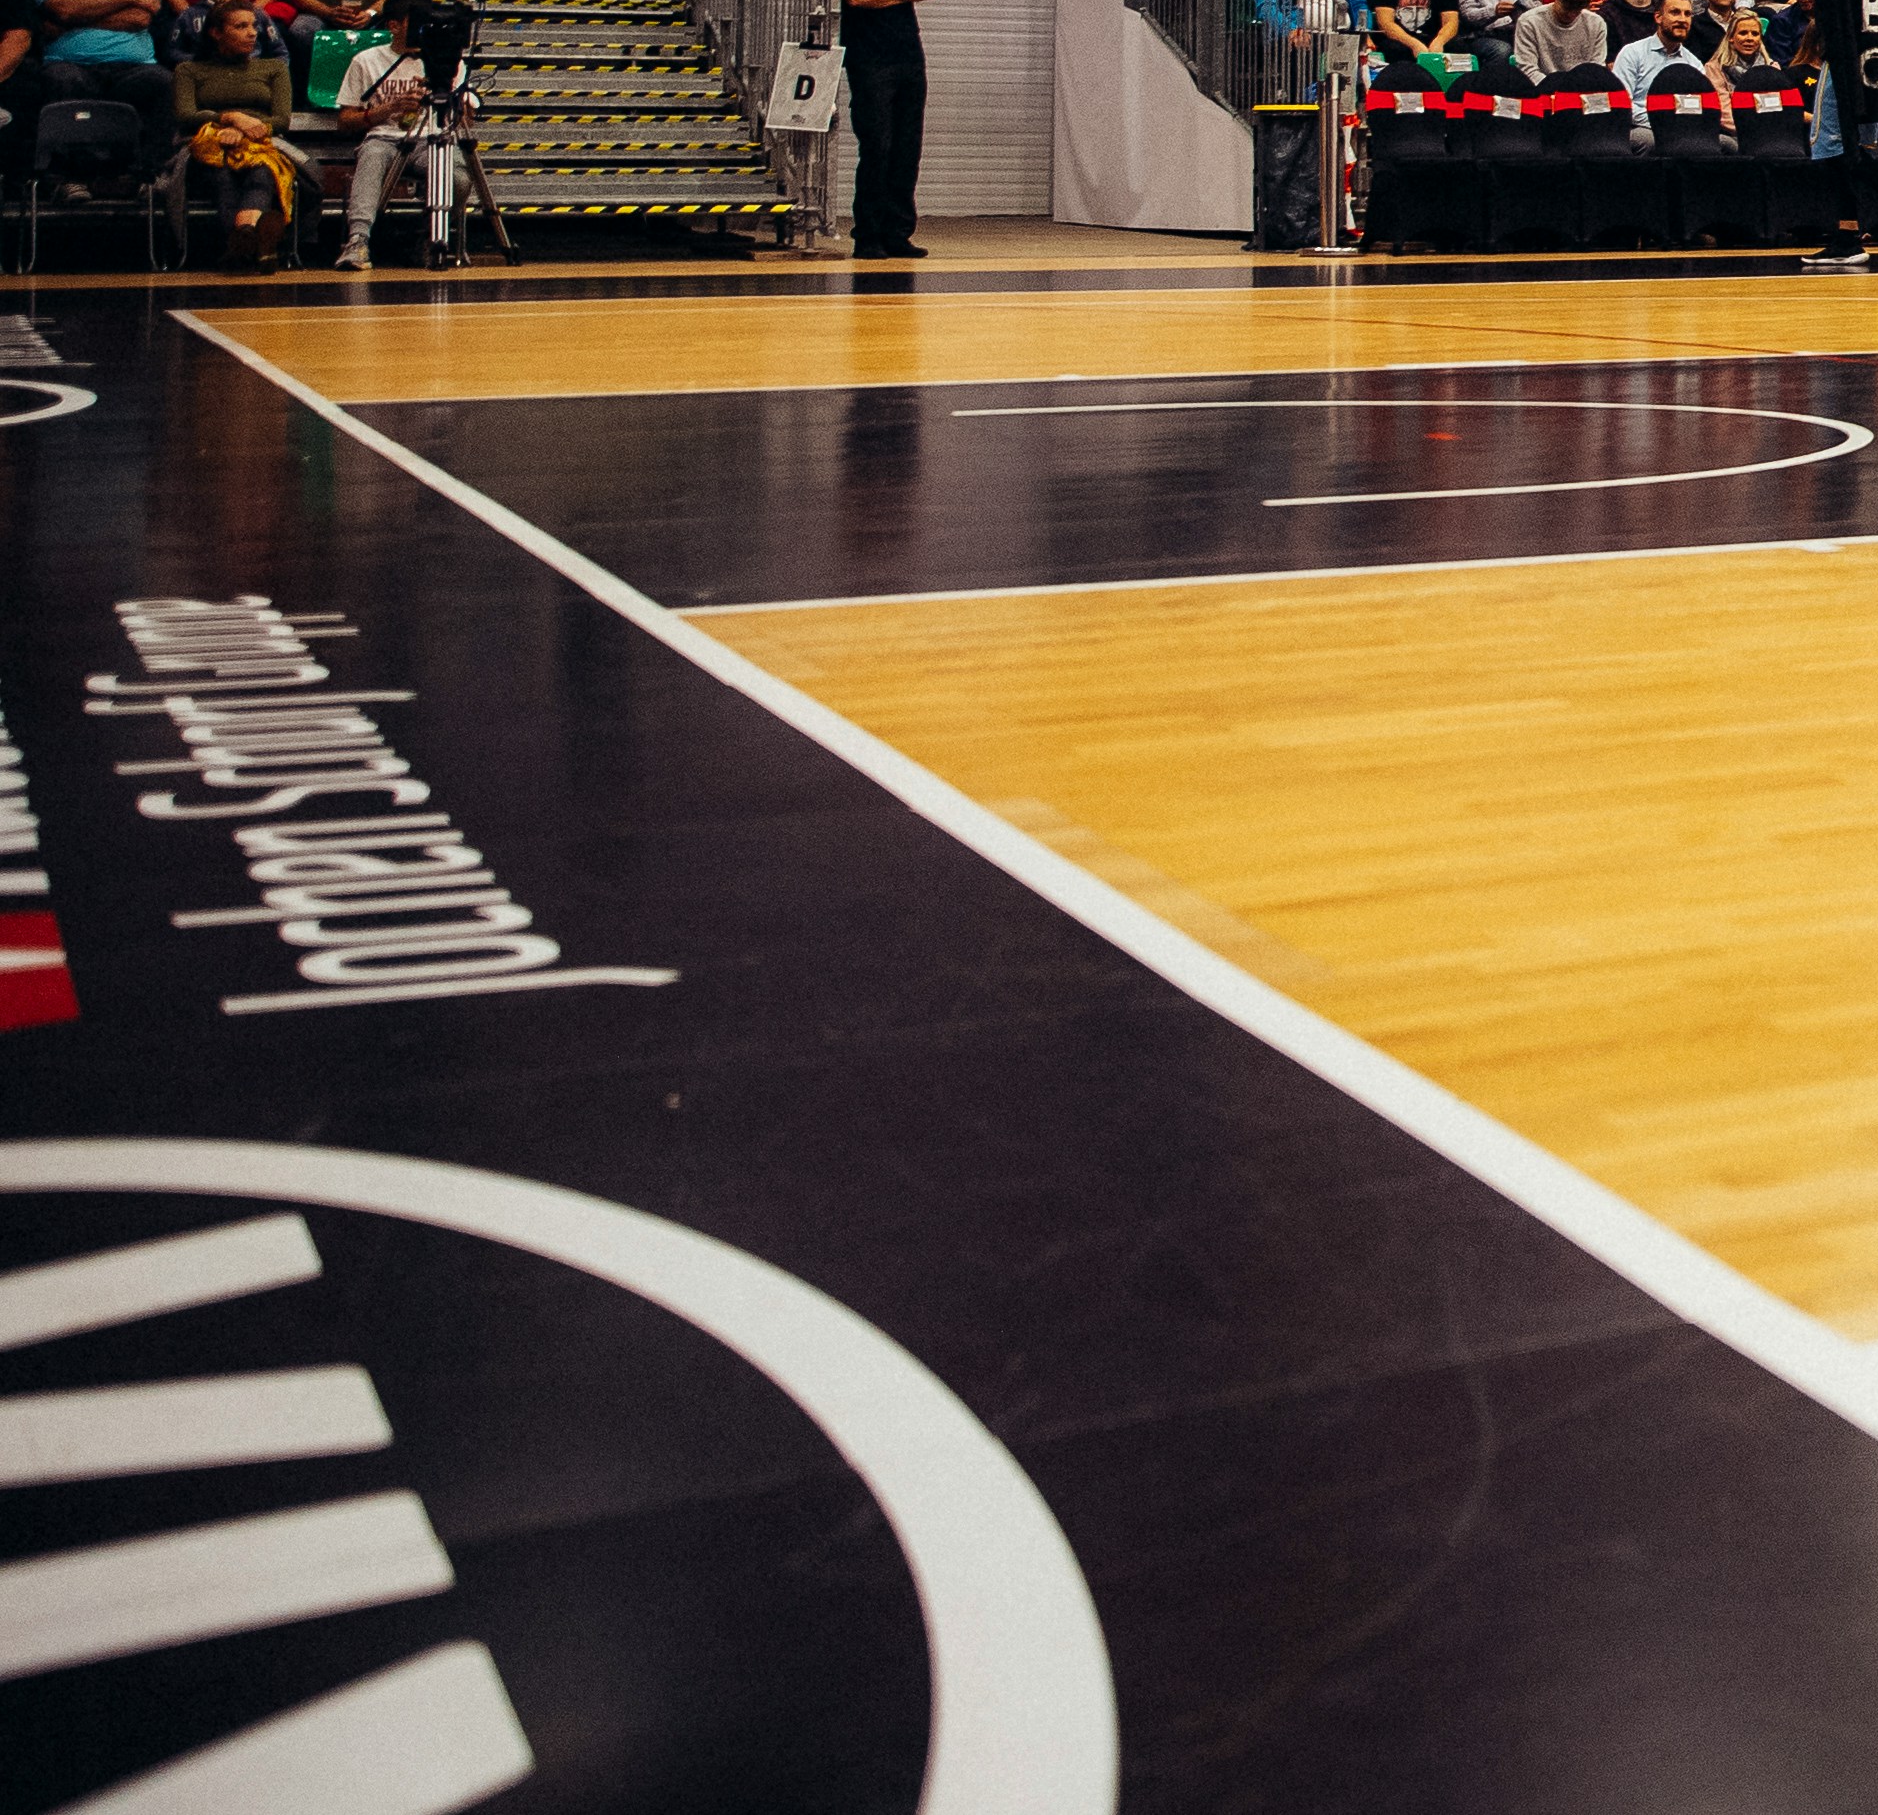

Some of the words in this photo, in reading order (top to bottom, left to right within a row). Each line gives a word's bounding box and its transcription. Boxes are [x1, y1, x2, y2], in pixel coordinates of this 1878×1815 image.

[793, 74, 815, 100] D
[81, 690, 430, 820] Scharf
[171, 813, 681, 1015] Jochen
